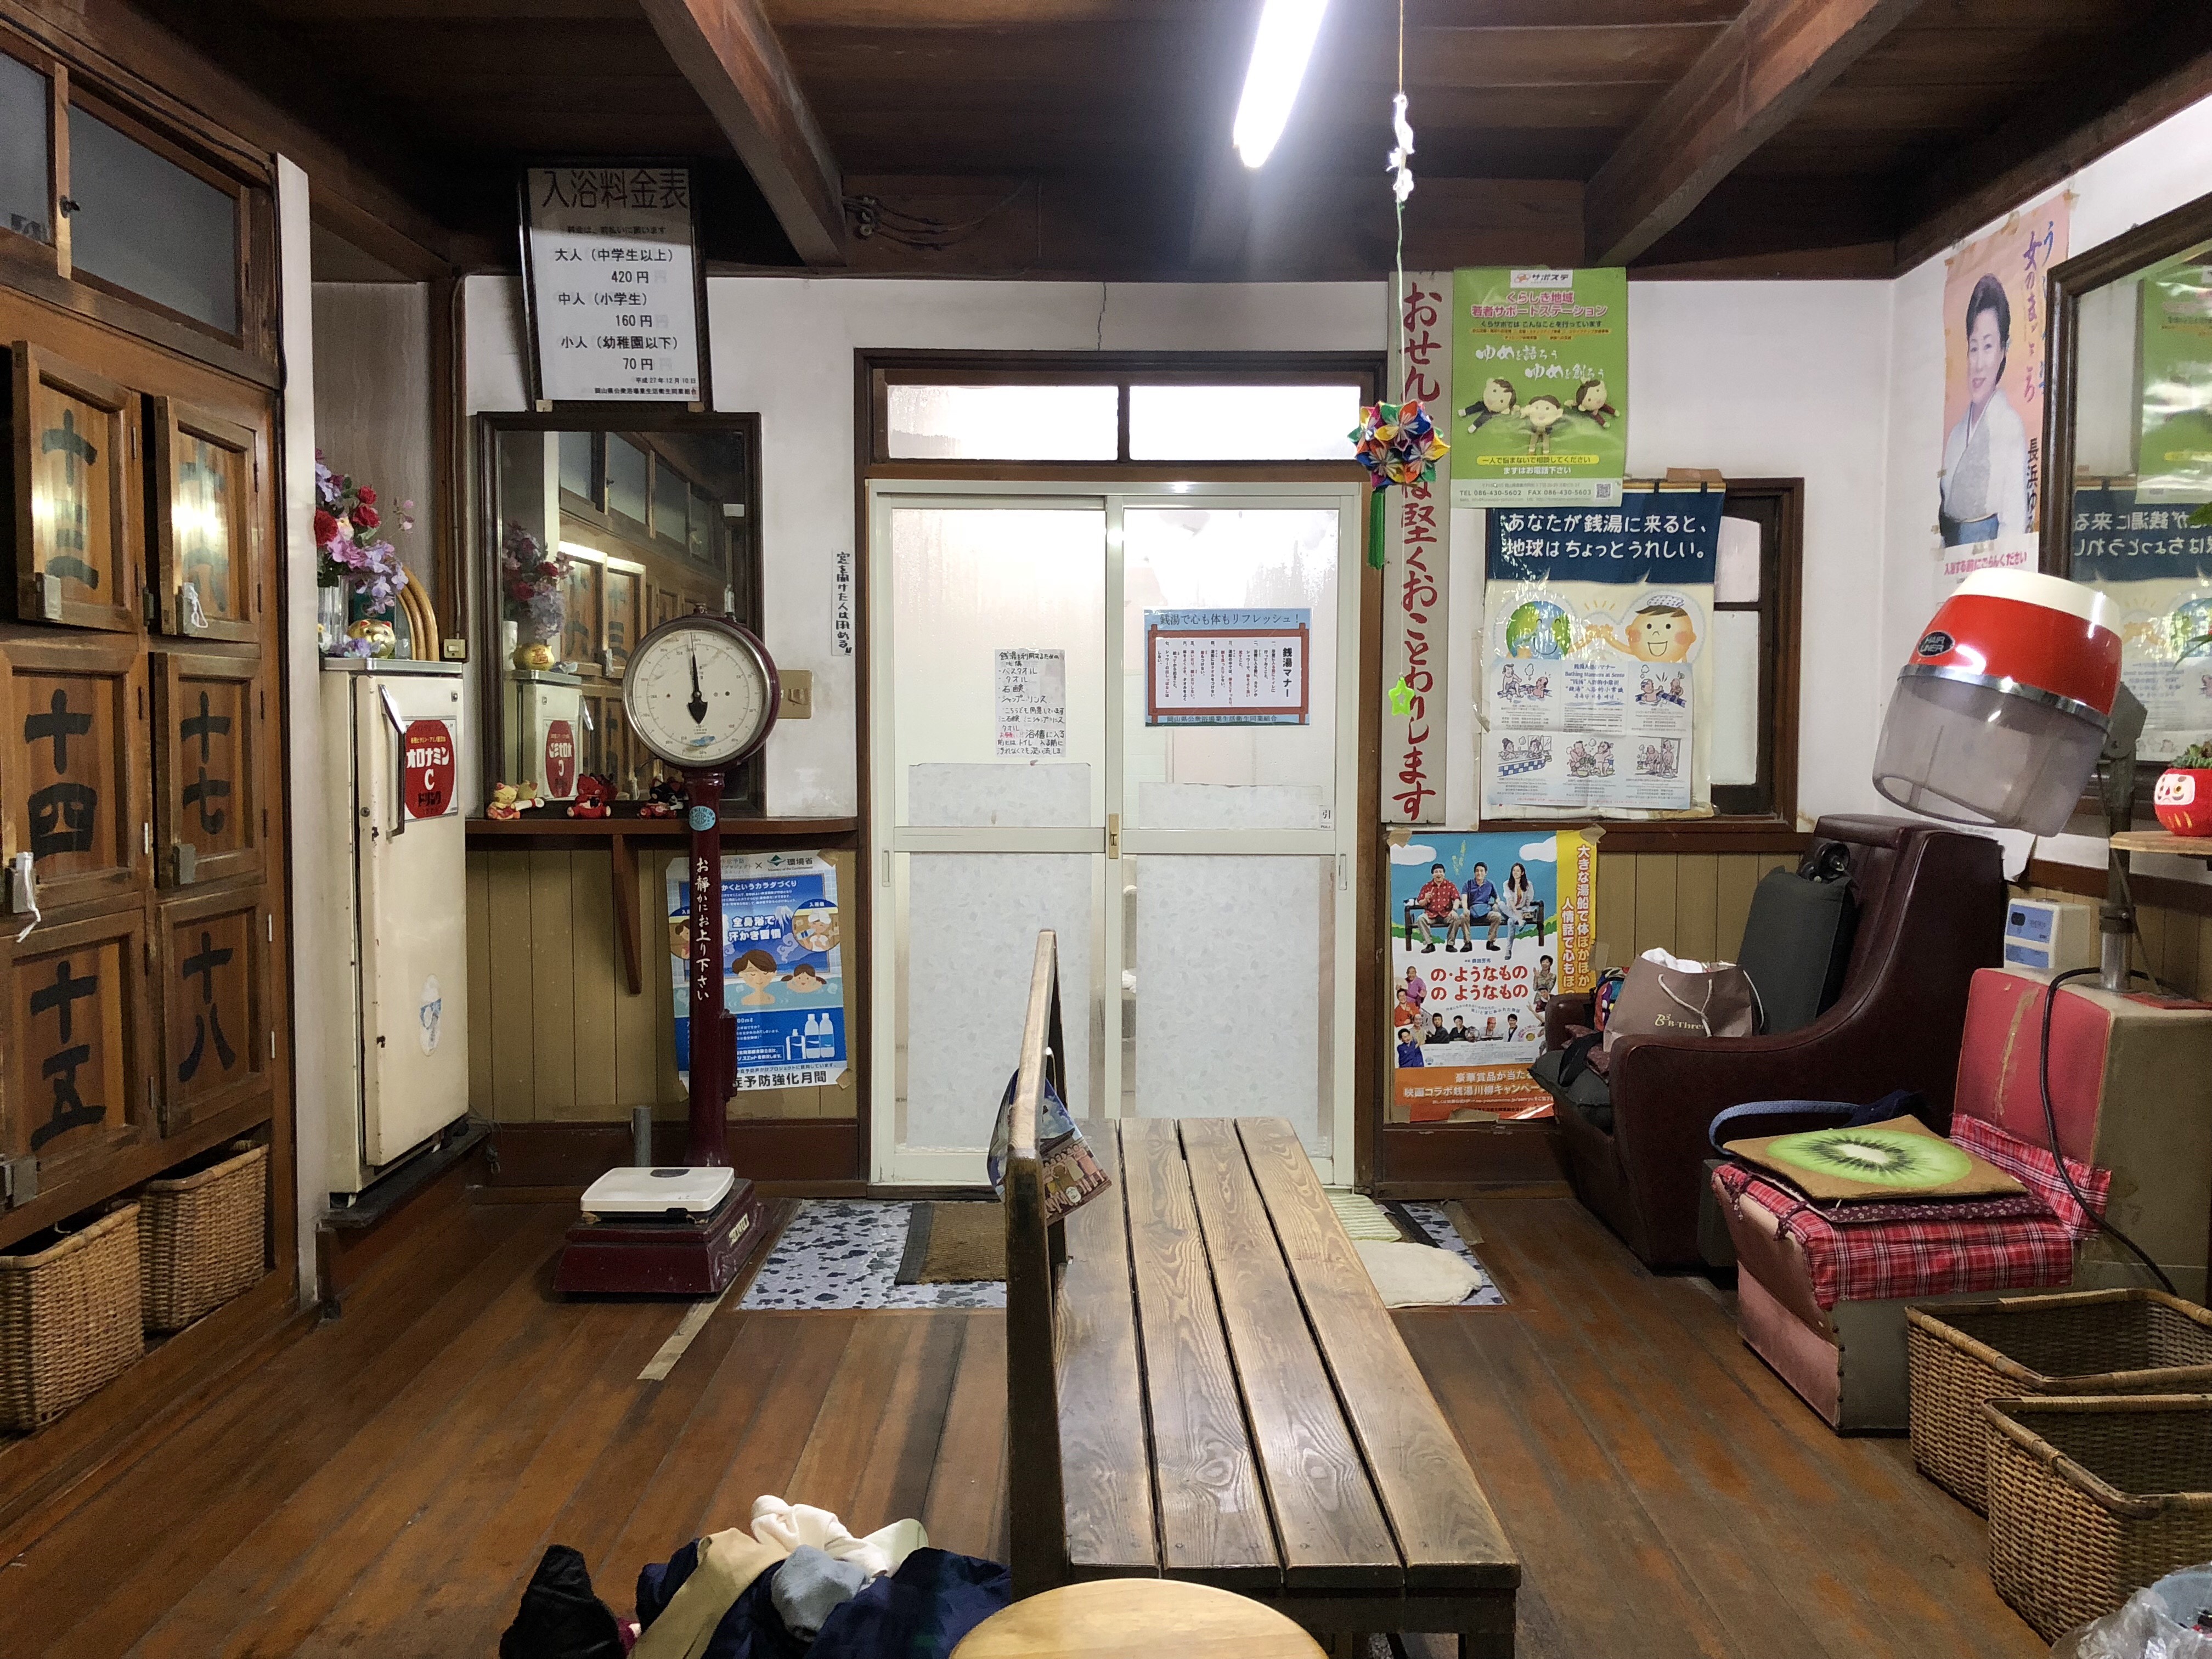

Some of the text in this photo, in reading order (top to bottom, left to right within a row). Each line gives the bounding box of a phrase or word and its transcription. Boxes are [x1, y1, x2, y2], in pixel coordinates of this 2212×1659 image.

[542, 170, 688, 209] 入浴料金表
[555, 248, 674, 262] 大人（中学生以上）
[558, 292, 647, 306] 中人（小学生）
[1506, 291, 1575, 304] くらしき地域
[1471, 305, 1608, 318] 若者サポートステーション
[561, 336, 679, 349] 小人（幼稚園以下）
[1503, 466, 1572, 475] まずはお電話下さい
[1507, 514, 1707, 533] あなたが銭湯に来ると、
[1392, 281, 1442, 821] おせんは堅くおことわりします
[1506, 539, 1706, 560] 地球はちょっとうれしい。
[1159, 613, 1300, 625] 銭湯で心も体もリフレッシュ！
[1283, 647, 1293, 698] 銭湯マナー
[180, 690, 232, 836] 十七
[407, 747, 450, 769] オロナミン
[24, 687, 98, 862] 十四
[425, 769, 435, 791] C
[1323, 810, 1331, 820] 引
[787, 857, 813, 866] 環境省
[721, 879, 797, 892] かくというカラダづくり
[732, 916, 776, 928] 全身浴で
[728, 928, 782, 942] 汗かき習慣
[1561, 898, 1575, 994] 人情話で心もほ
[178, 930, 237, 1083] 十八
[29, 960, 107, 1152] 十五
[733, 1070, 827, 1088] 症予防強化月間
